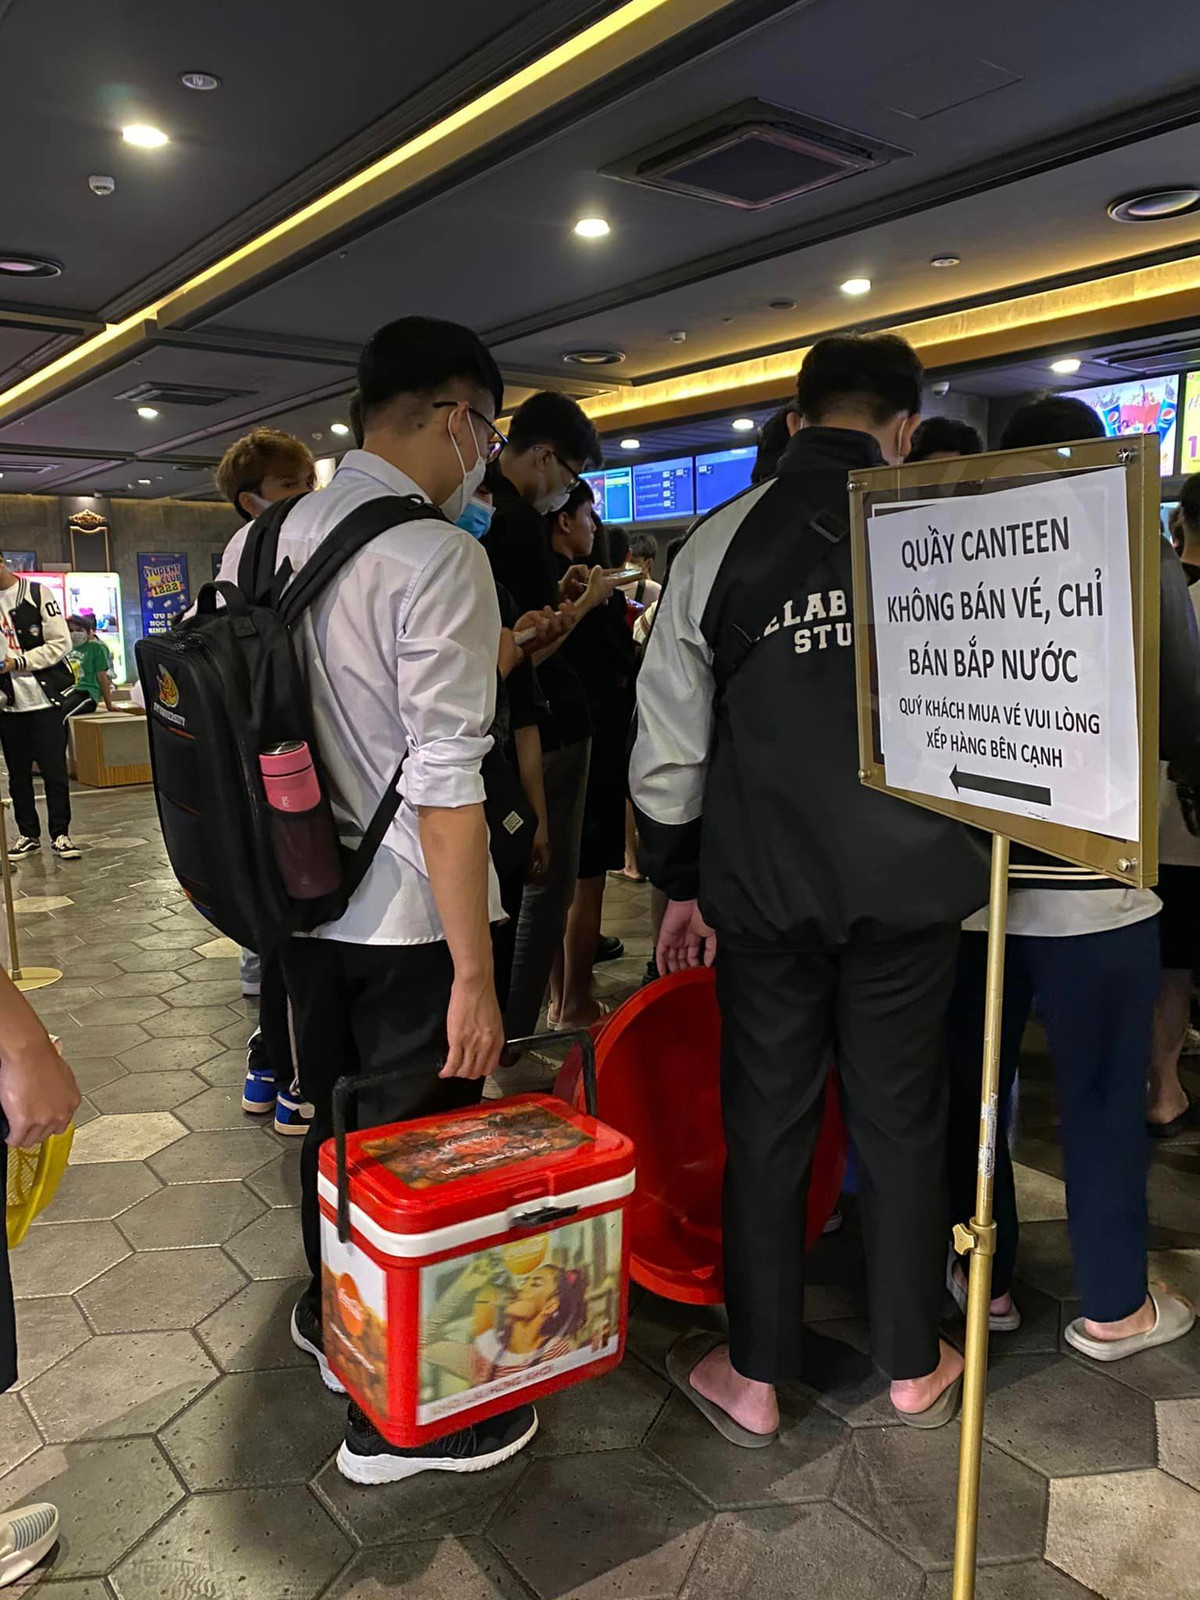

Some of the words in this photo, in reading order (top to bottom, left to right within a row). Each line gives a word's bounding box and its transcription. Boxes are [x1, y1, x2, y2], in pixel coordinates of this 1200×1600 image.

[901, 525, 954, 571] QUẦY
[961, 516, 1069, 562] CANTEEN
[144, 564, 180, 577] STUDENT
[154, 582, 179, 595] 1222
[161, 574, 182, 584] CLUB
[887, 587, 955, 622] KHÔNG
[960, 581, 1006, 620] BÁN
[1012, 577, 1051, 624] VÉ,
[1058, 568, 1103, 617] CHỈ
[909, 641, 948, 676] BÁN
[954, 635, 994, 678] BẮP
[1002, 641, 1078, 683] NƯỚC
[899, 695, 922, 716] QUÝ
[925, 697, 964, 719] KHÁCH
[969, 704, 1000, 723] MUA
[1004, 702, 1021, 726] VÉ
[1024, 708, 1050, 729] VUI
[1055, 706, 1100, 734] LÒNG
[926, 726, 947, 749] XẾP
[951, 732, 986, 756] HÀNG
[991, 736, 1017, 761] BÊN
[1021, 744, 1063, 768] CẠNH
